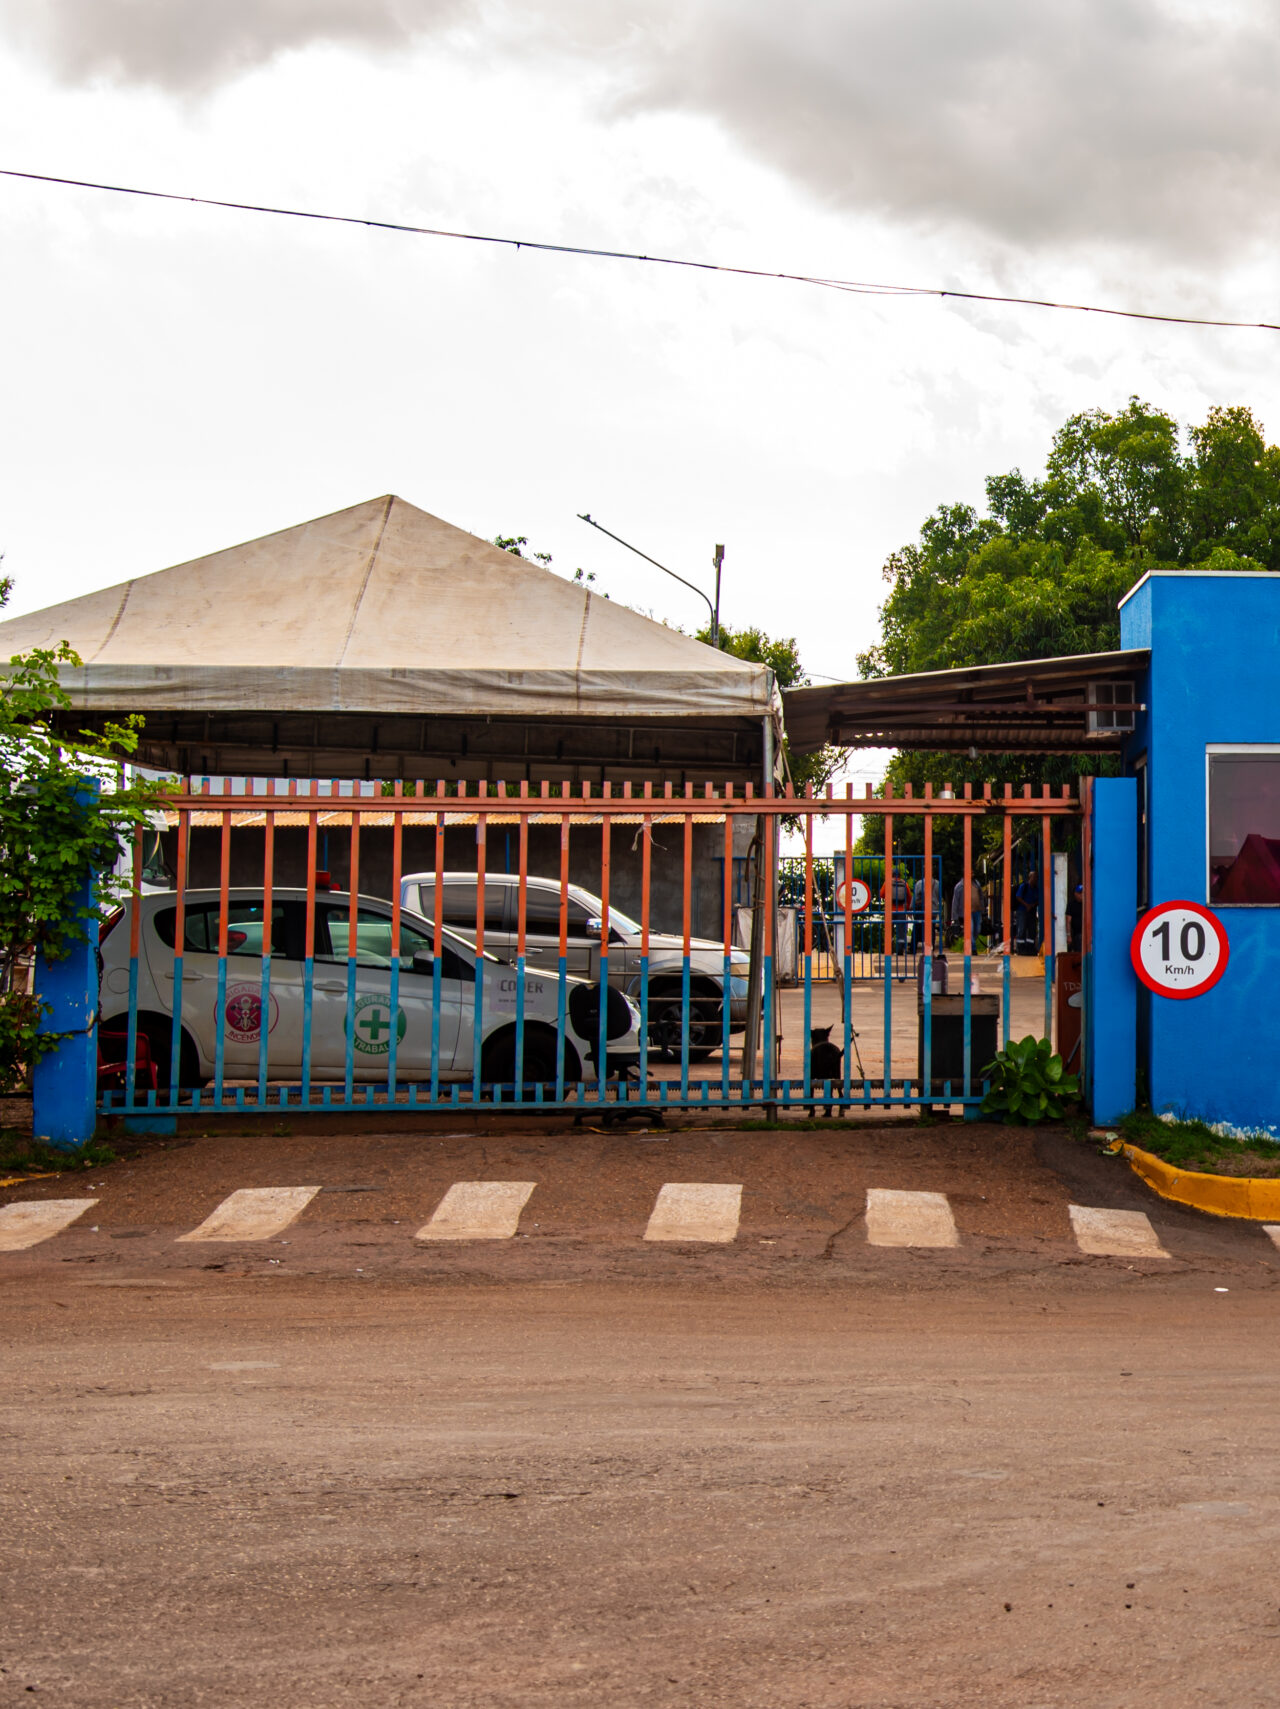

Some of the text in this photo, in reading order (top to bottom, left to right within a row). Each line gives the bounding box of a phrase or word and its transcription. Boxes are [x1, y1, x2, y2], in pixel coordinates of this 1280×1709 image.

[1152, 921, 1206, 961] 10
[1165, 965, 1195, 975] Km/h
[500, 979, 544, 994] COER
